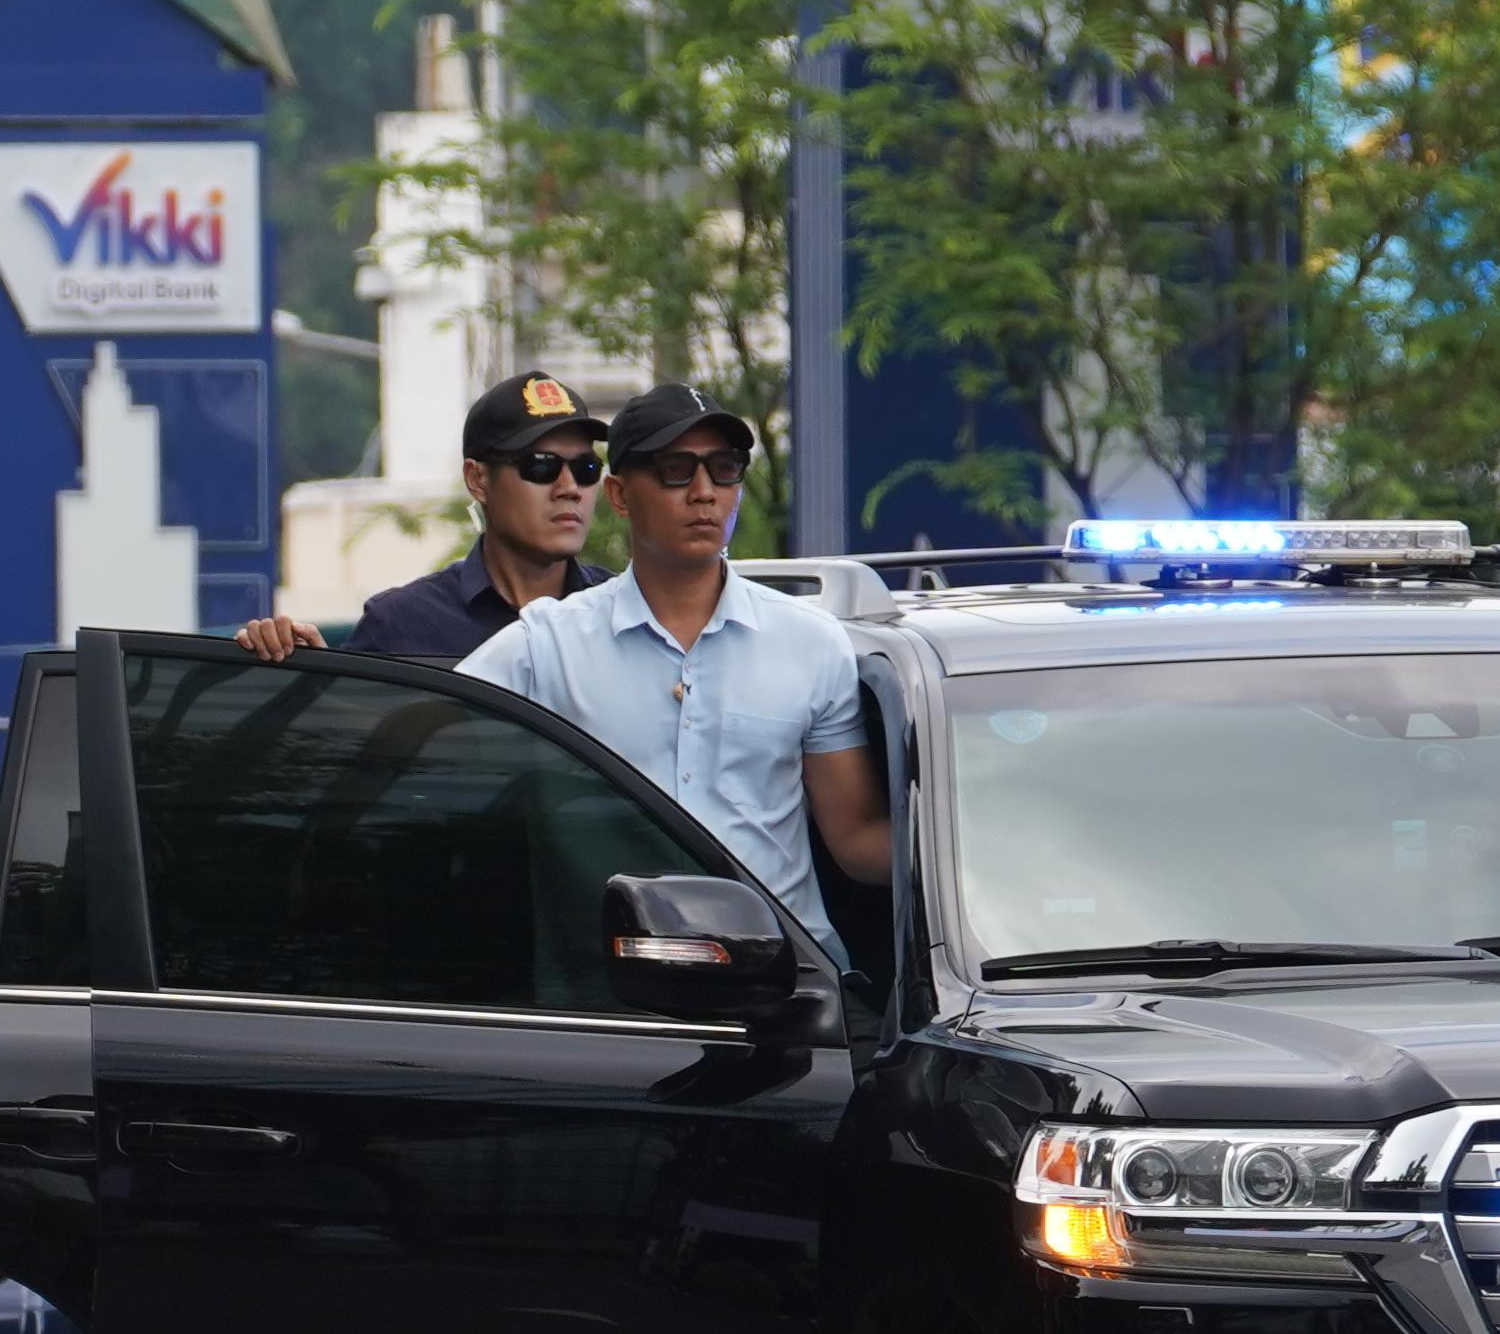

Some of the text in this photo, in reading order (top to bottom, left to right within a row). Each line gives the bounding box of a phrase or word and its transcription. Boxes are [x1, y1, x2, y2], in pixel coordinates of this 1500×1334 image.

[22, 149, 223, 267] Vikki
[59, 277, 219, 304] Digital Bank
